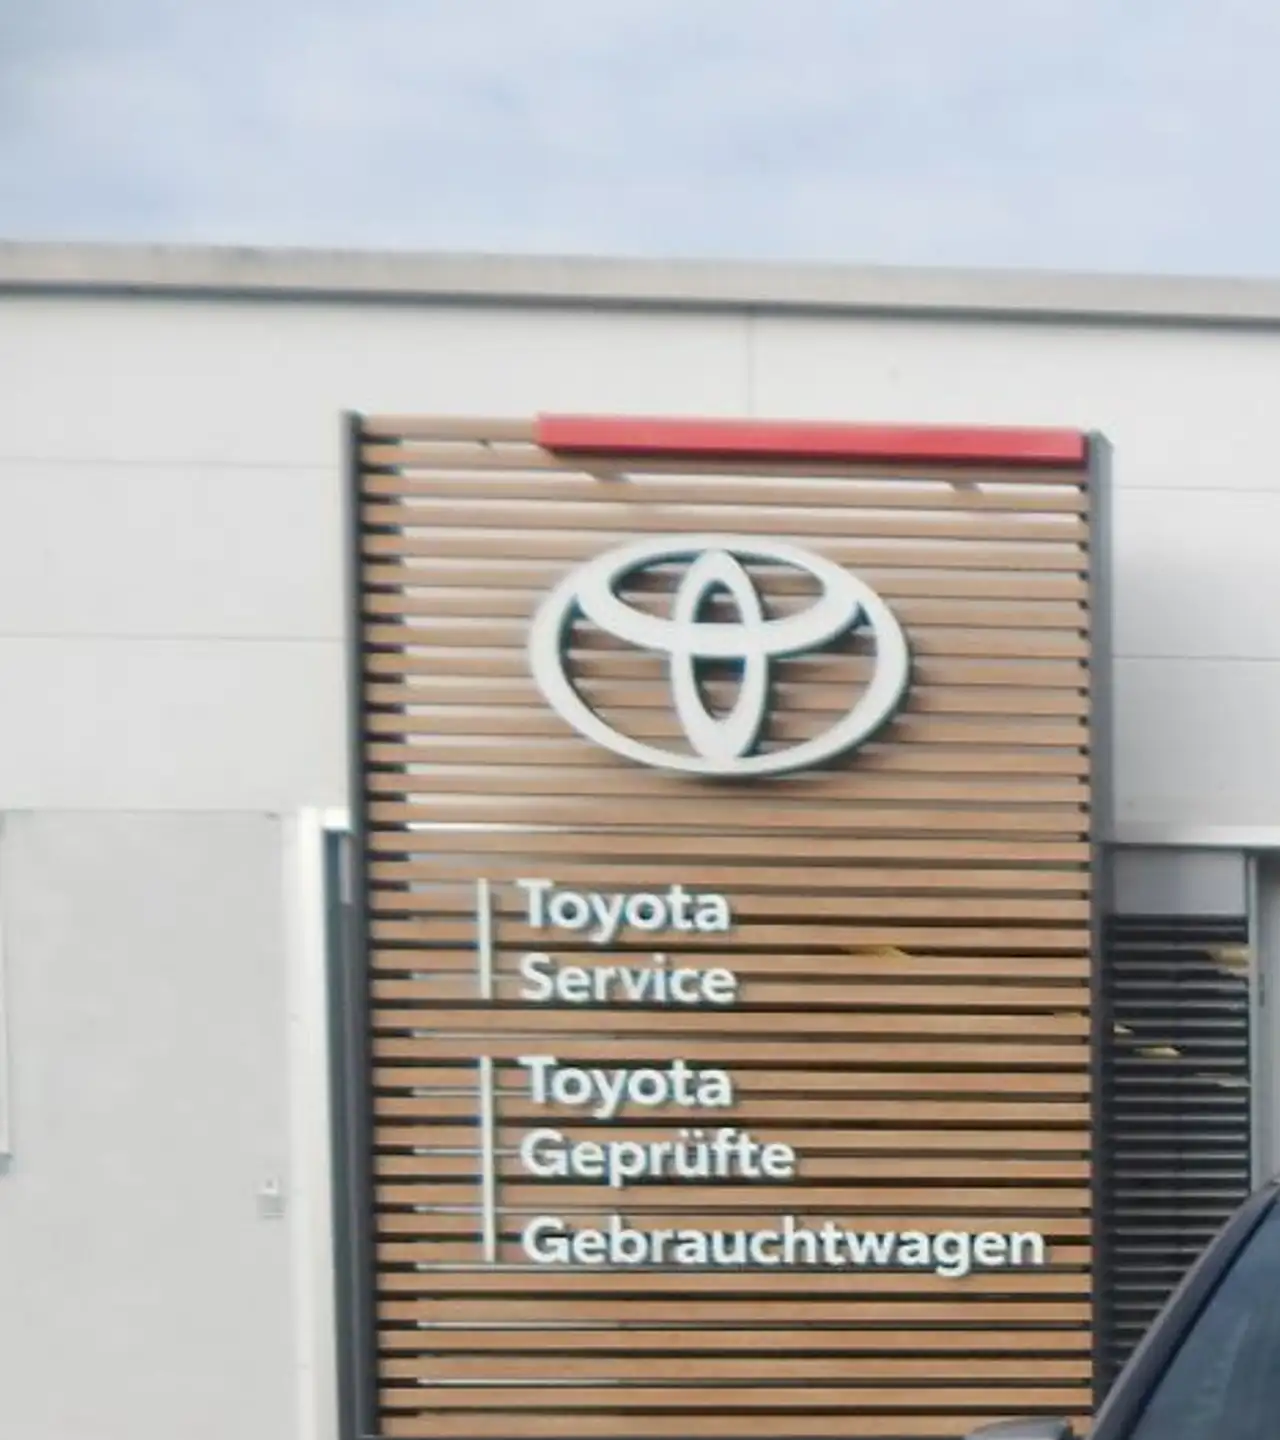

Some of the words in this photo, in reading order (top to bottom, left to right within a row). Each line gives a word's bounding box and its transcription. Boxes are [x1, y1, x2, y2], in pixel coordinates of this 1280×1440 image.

[516, 877, 731, 944] Toyota
[518, 952, 739, 1004] Service
[517, 1055, 734, 1118] Toyota
[519, 1127, 797, 1187] Geprüfte
[520, 1214, 1046, 1276] Gebrauchtwagen
